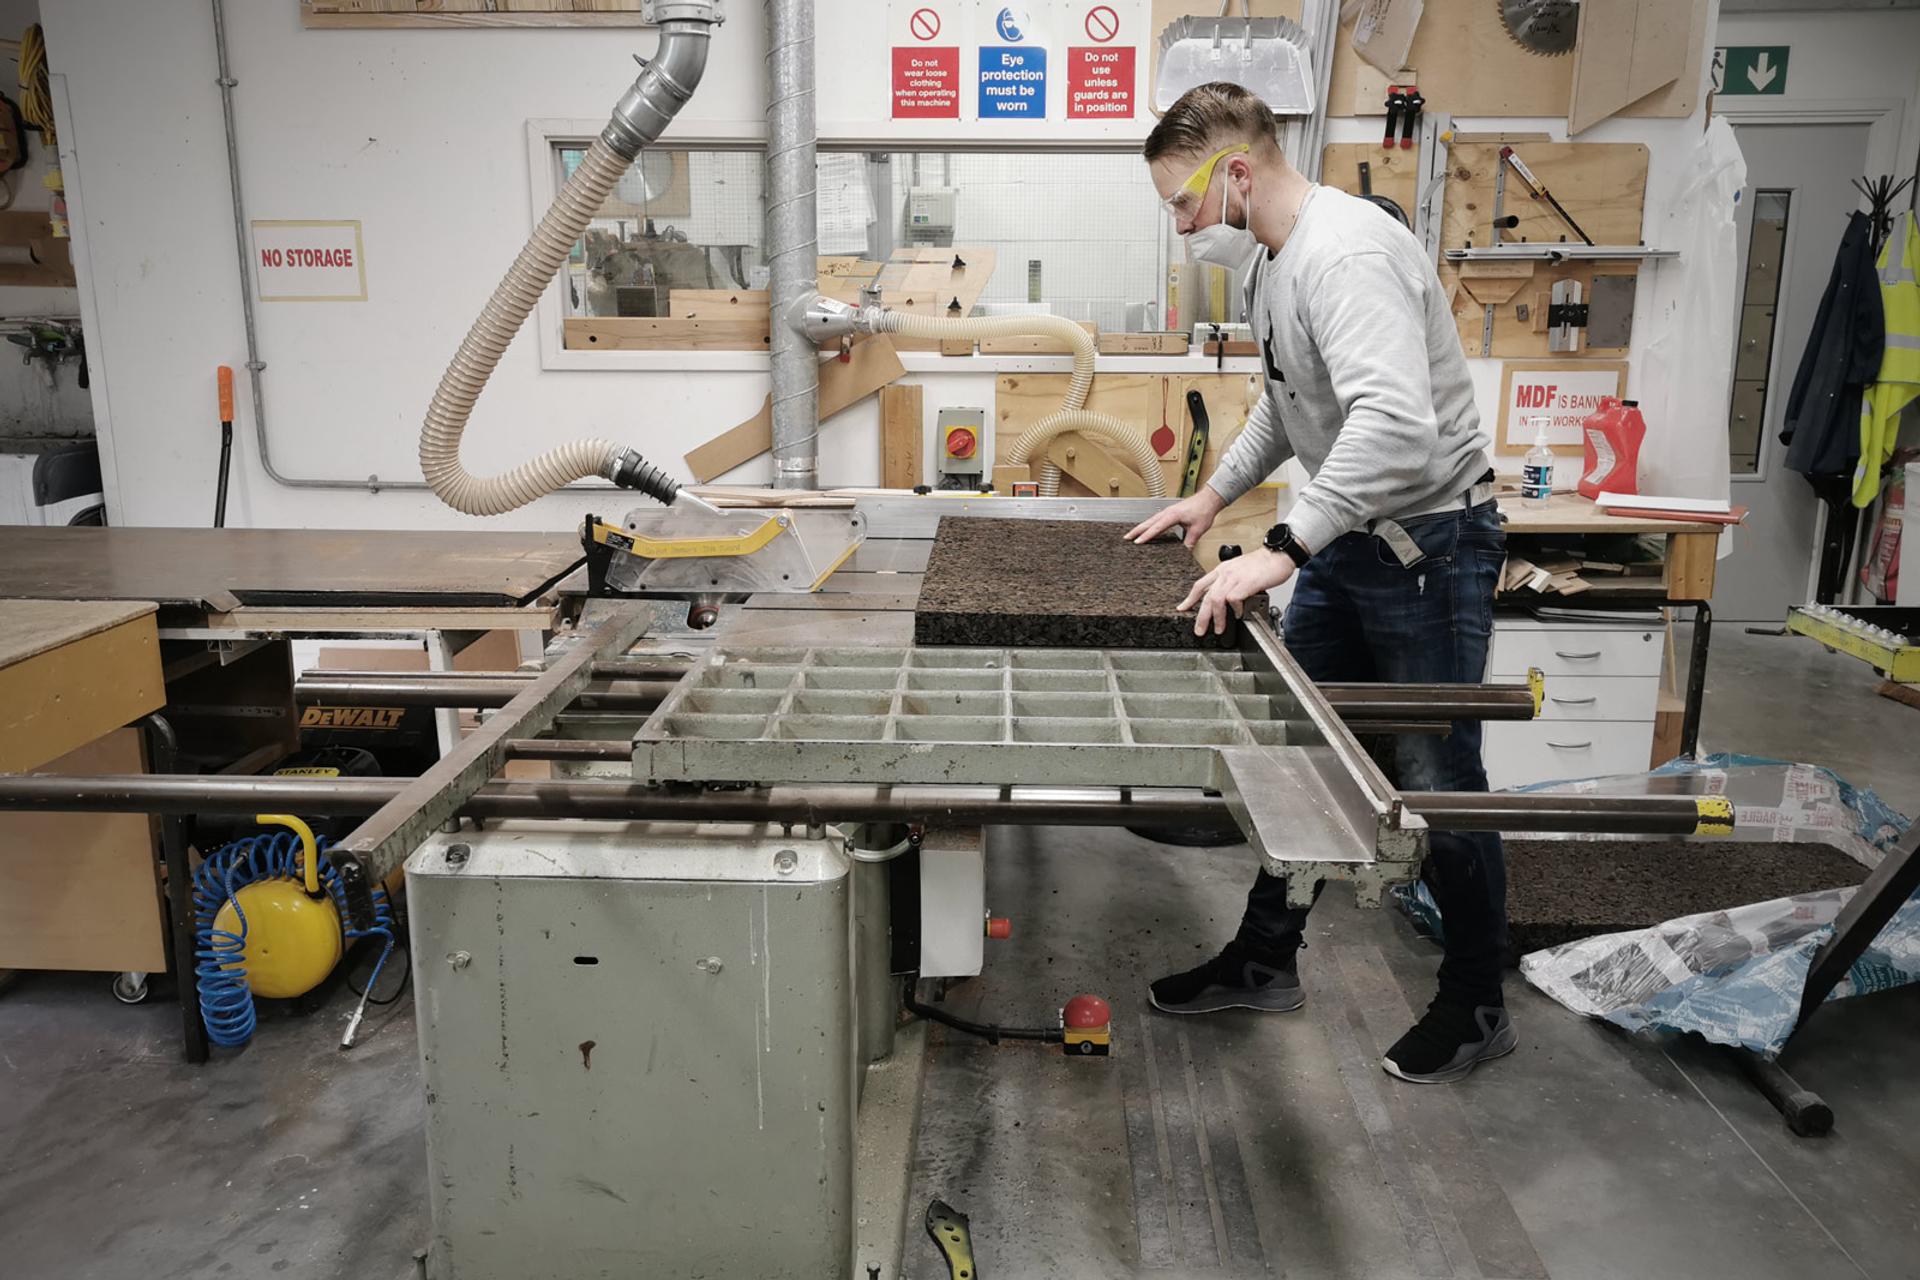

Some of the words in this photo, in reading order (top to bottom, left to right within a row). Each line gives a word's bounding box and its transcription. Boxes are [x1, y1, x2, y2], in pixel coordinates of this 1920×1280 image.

[1001, 53, 1024, 67] Eye
[1084, 52, 1099, 62] Do
[1101, 53, 1119, 62] not
[911, 58, 923, 67] Do
[925, 59, 938, 67] not
[925, 69, 948, 77] loose
[981, 69, 1043, 82] protection
[1091, 66, 1111, 75] use
[909, 79, 942, 88] clothing
[1084, 77, 1118, 87] unless
[895, 89, 917, 97] when
[918, 89, 956, 98] operating
[986, 85, 1017, 96] must
[1019, 84, 1035, 96] be
[1074, 90, 1109, 101] guards
[1111, 91, 1128, 100] are
[900, 99, 915, 107] this
[917, 99, 951, 107] machine
[996, 102, 1028, 111] worn
[1074, 102, 1084, 112] in
[1086, 102, 1127, 114] position
[261, 248, 282, 267] NO
[286, 248, 353, 267] STORAGE
[1516, 384, 1558, 408] MDF
[1558, 395, 1568, 409] IS
[1519, 415, 1528, 426] IN
[276, 768, 333, 776] STANLEY
